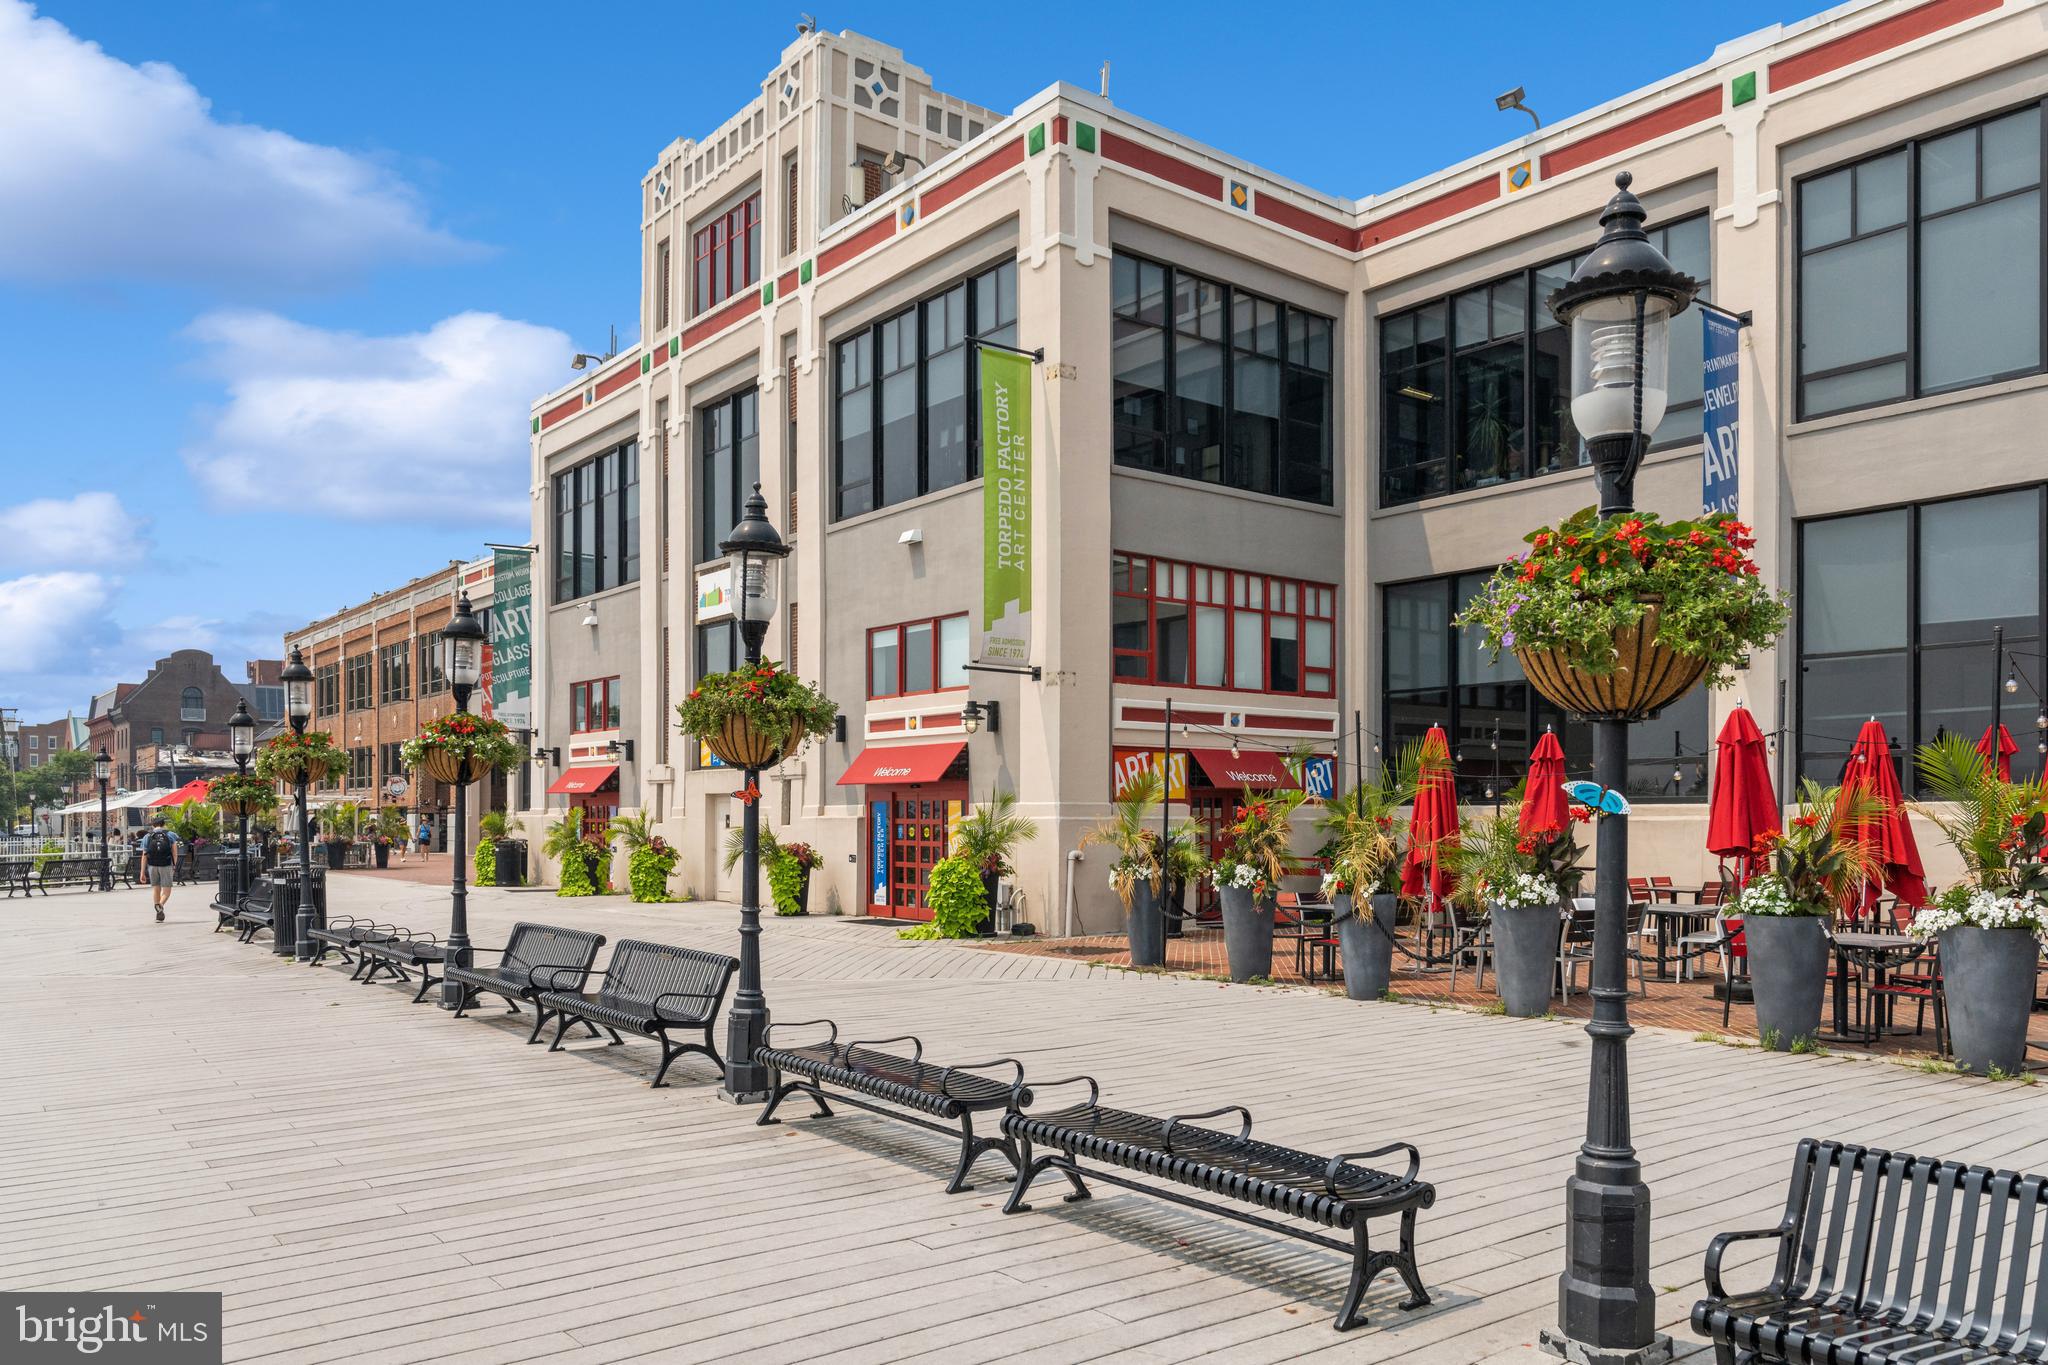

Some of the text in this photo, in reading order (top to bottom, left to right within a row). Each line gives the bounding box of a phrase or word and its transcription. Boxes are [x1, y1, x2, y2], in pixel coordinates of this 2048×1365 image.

[1704, 421, 1738, 486] ART
[995, 381, 1012, 569] TORPEDO FACTORY
[1013, 434, 1025, 571] ART CENTER
[494, 584, 531, 604] COLLAGE
[493, 605, 530, 642] ART
[493, 643, 530, 667] GLASS
[988, 646, 1024, 659] SINCE 1974
[493, 667, 530, 685] SCULPTURE
[873, 767, 912, 777] Welcome
[1114, 751, 1150, 798] ART
[1225, 770, 1278, 783] Welcome
[1305, 759, 1333, 797] ART
